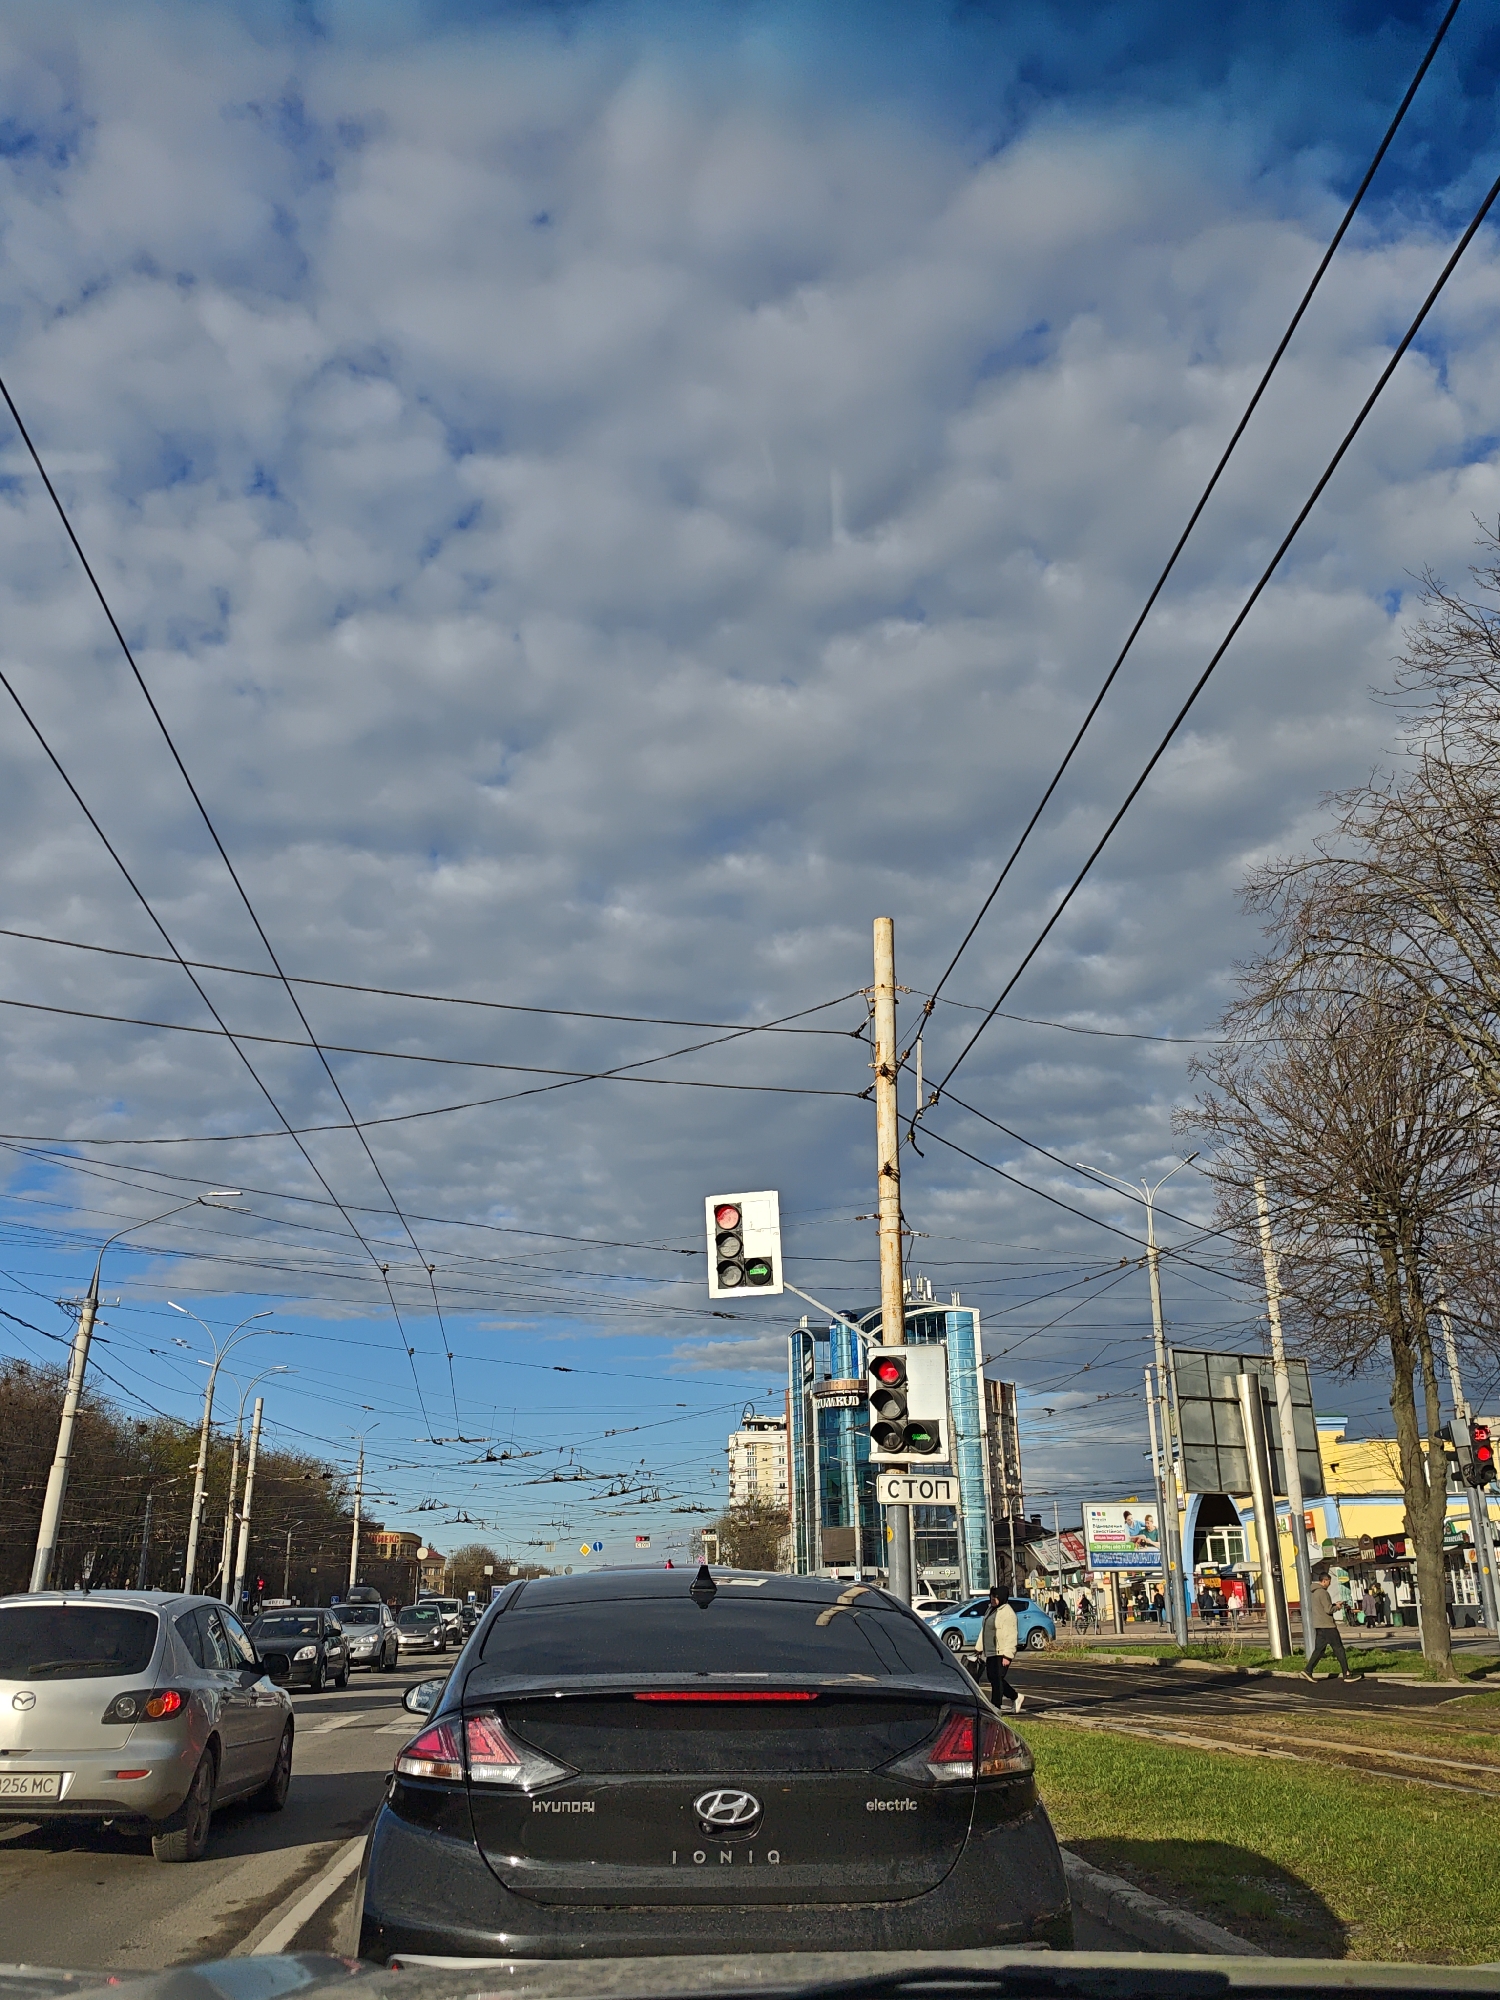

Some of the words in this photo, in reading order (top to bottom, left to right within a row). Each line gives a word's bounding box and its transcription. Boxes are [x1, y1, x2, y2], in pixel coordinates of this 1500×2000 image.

[888, 1480, 950, 1499] СТОП
[0, 1777, 29, 1793] 256
[532, 1801, 595, 1813] HYUNDAI
[866, 1797, 918, 1811] electric
[672, 1850, 780, 1865] IONIQ
